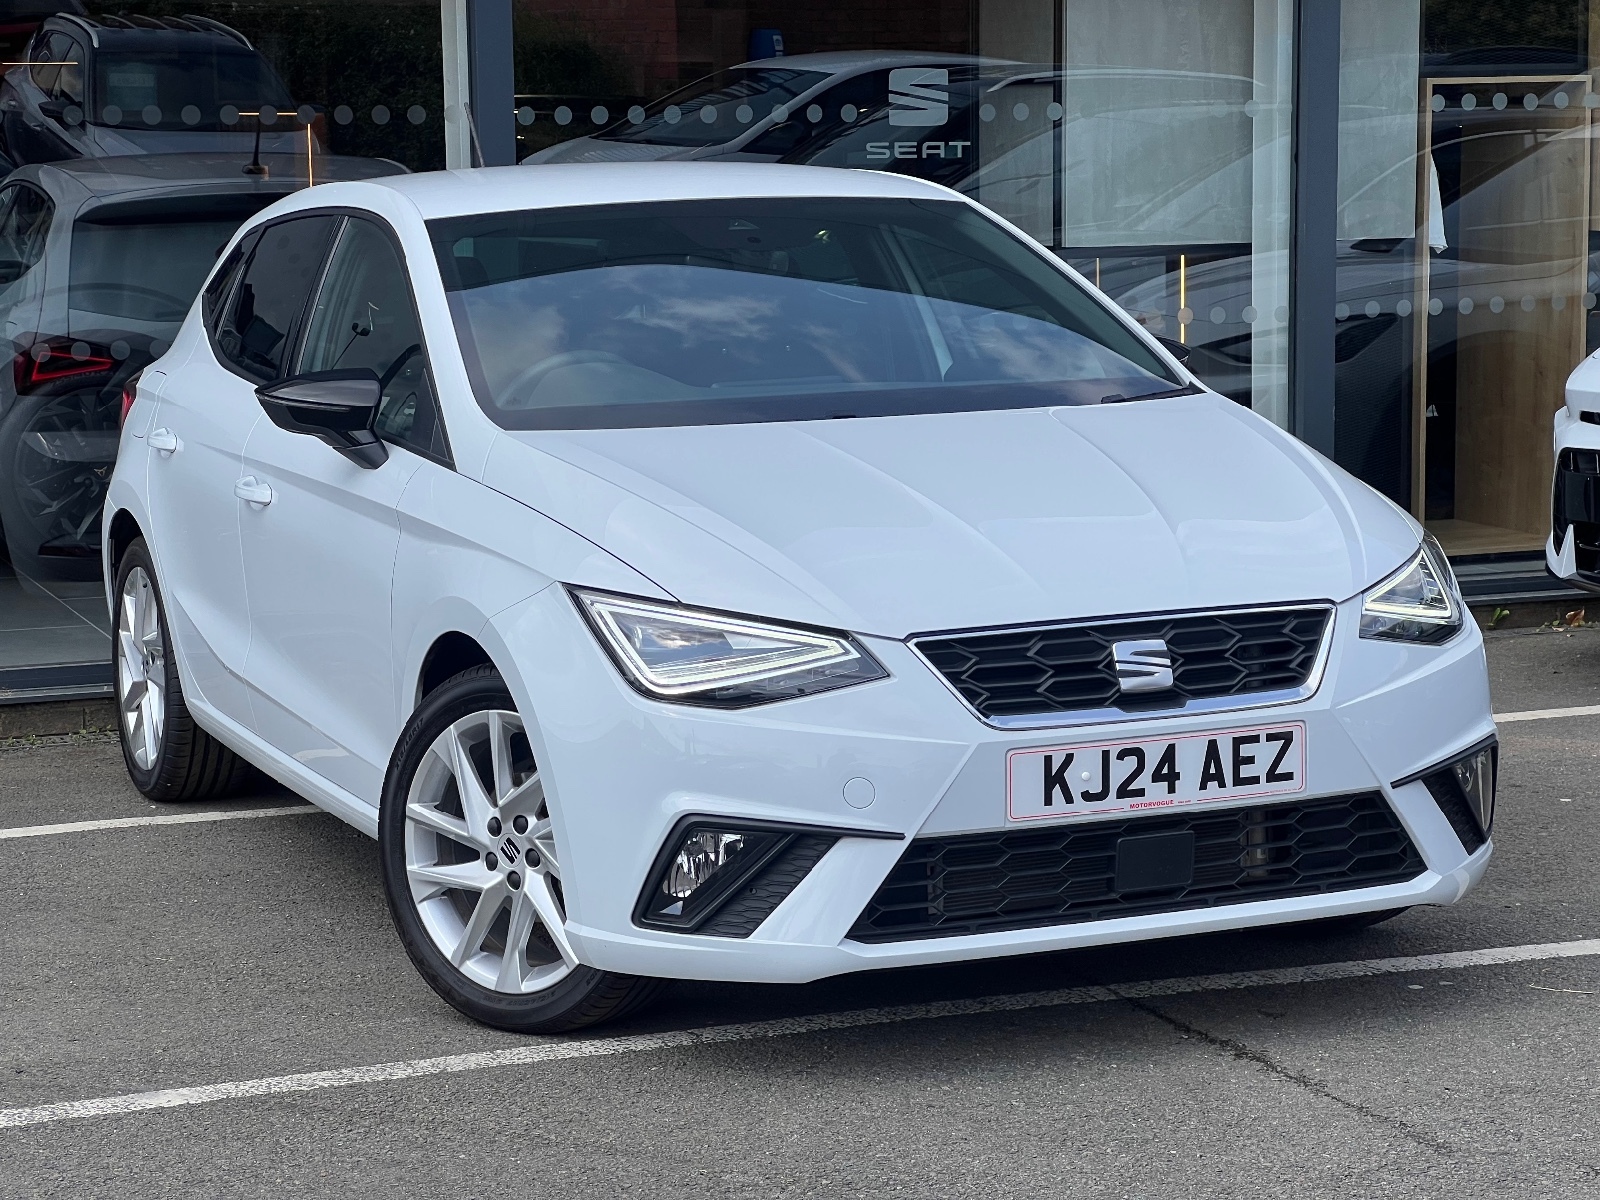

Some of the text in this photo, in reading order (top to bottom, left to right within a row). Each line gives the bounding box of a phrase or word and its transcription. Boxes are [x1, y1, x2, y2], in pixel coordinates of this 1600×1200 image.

[865, 141, 971, 159] SEAT
[1043, 730, 1294, 807] KJ24 AEZ
[1129, 799, 1175, 810] MOTORVOGUE
